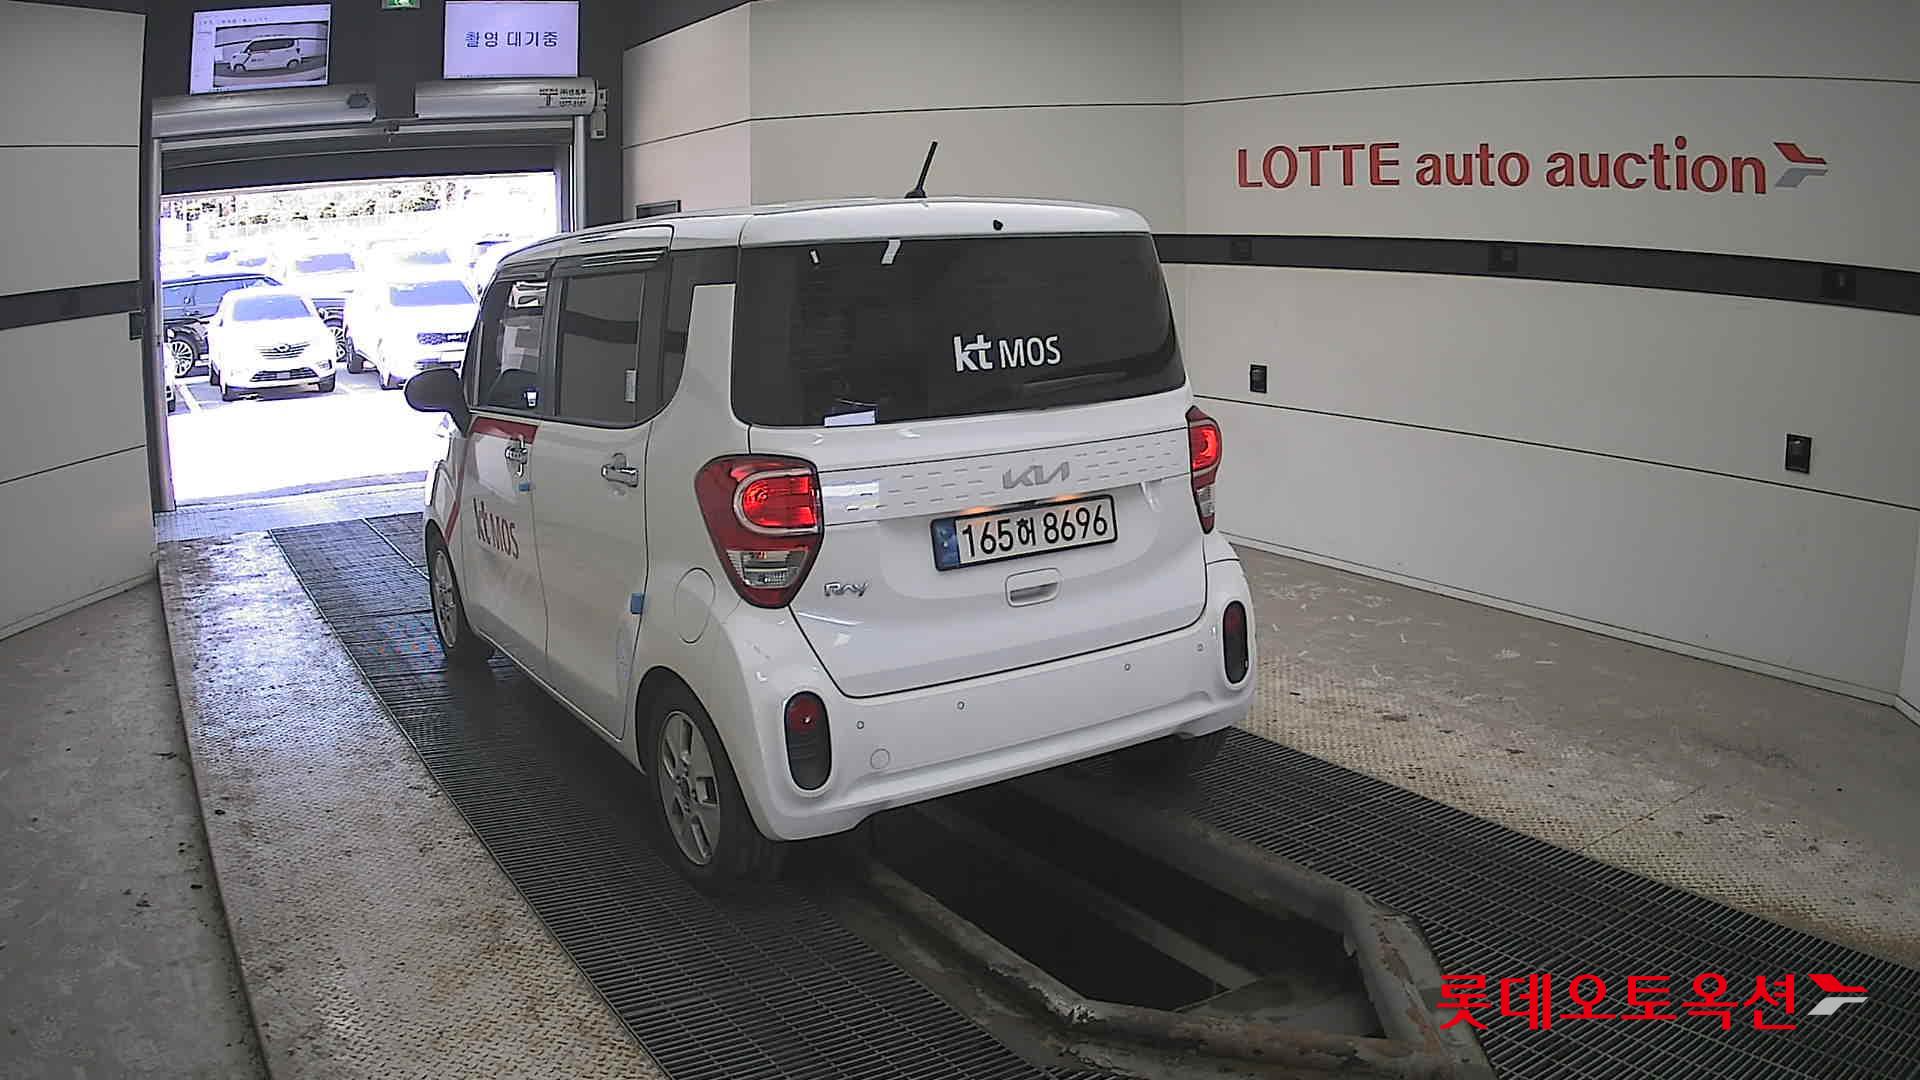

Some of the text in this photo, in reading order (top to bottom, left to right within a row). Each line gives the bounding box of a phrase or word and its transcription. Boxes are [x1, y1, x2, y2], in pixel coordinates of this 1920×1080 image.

[464, 31, 559, 48] 촬영 대기중
[1238, 135, 1767, 194] LOTTE auto auction
[953, 334, 1061, 372] kt MOS
[489, 512, 519, 560] MOS
[961, 504, 1108, 558] 165허 8696
